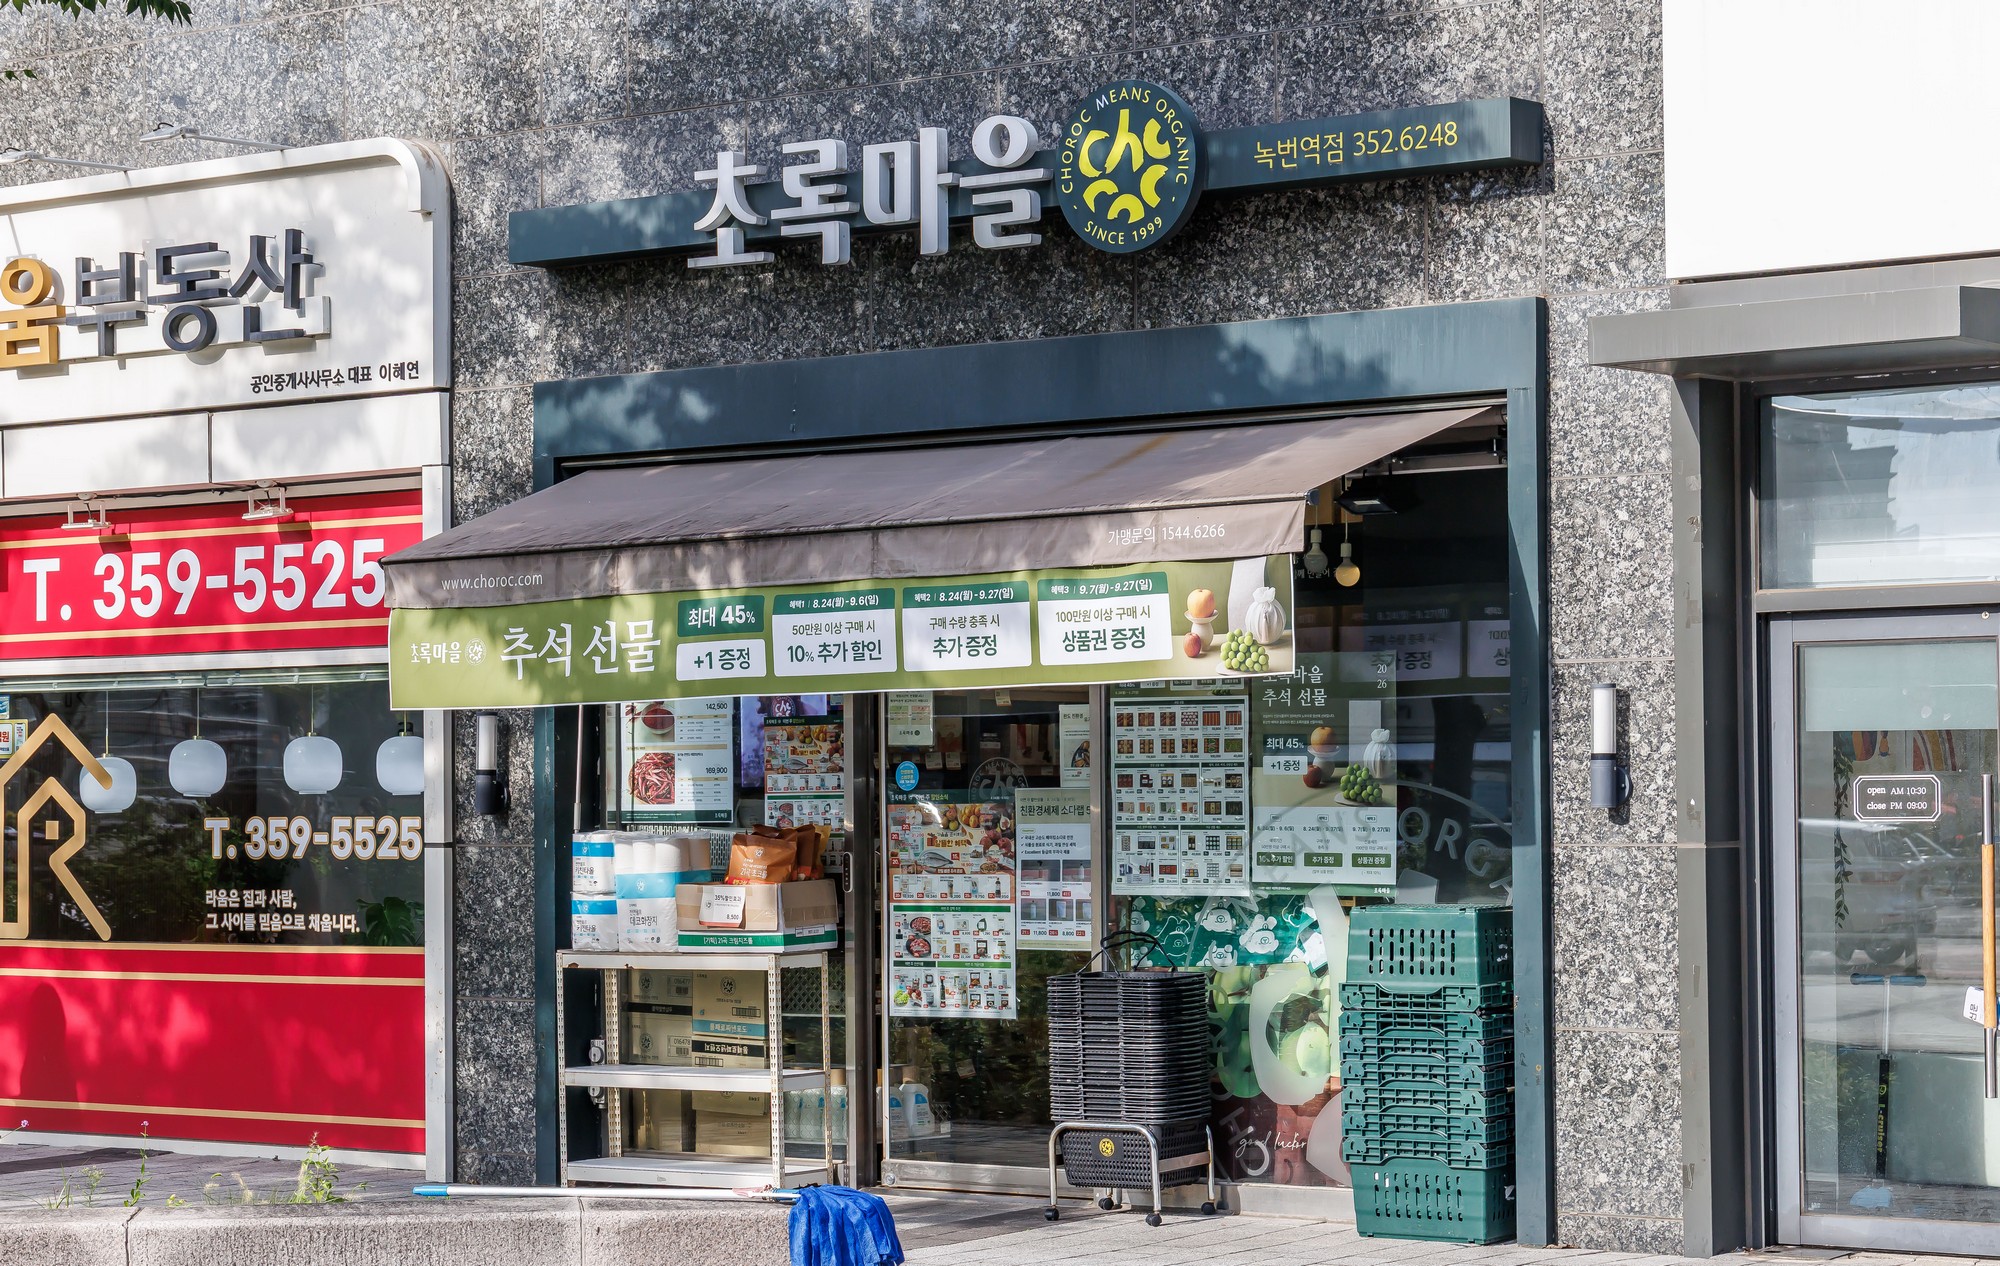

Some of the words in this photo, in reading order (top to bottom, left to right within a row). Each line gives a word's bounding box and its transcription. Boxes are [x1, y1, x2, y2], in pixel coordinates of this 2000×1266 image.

[1061, 109, 1092, 194] CHOROC
[1096, 87, 1151, 112] MEANS
[1155, 98, 1190, 186] ORGANIC
[1254, 132, 1344, 169] 녹번역점
[1353, 121, 1458, 157] 352.6248
[687, 115, 1053, 269] 초록마을
[1084, 220, 1125, 245] SINCE
[1132, 216, 1162, 242] 1999
[250, 371, 345, 394] 공인중개사사무소
[347, 366, 373, 383] 대표
[379, 360, 420, 383] 이혜연
[1108, 527, 1155, 546] 가맹문의
[1162, 524, 1225, 541] 1544.6266
[23, 557, 73, 622] T.
[93, 538, 385, 620] 359-5525
[441, 572, 543, 591] www.choroc.com
[914, 592, 931, 602] 혜택2
[1050, 585, 1069, 595] 혜택3
[789, 600, 805, 609] 혜택1
[688, 607, 716, 628] 최대
[721, 605, 755, 625] 45%
[929, 616, 947, 629] 구매
[949, 615, 967, 629] 수량
[969, 614, 988, 628] 충족
[990, 613, 1000, 627] 시
[1055, 608, 1091, 624] 100만원
[1094, 607, 1113, 622] 이상
[1115, 606, 1138, 621] 구매
[1140, 605, 1151, 619] 시
[792, 622, 822, 636] 50만원
[824, 621, 842, 635] 이상
[844, 620, 864, 634] 구매
[866, 619, 876, 633] 시
[932, 636, 962, 659] 추가
[965, 634, 998, 657] 증정
[1062, 630, 1107, 652] 상품권
[1110, 626, 1146, 649] 증정
[410, 640, 462, 664] 초록마을
[500, 622, 572, 680] 추석
[583, 618, 661, 675] 선물
[787, 645, 814, 663] 10%
[817, 641, 848, 664] 추가
[851, 639, 882, 662] 할인
[694, 651, 713, 670] +1
[718, 647, 750, 671] 증정
[1377, 664, 1387, 674] 20
[1377, 679, 1387, 689] 26
[706, 703, 728, 711] 142,500
[1262, 688, 1291, 708] 추석
[1298, 688, 1327, 707] 선물
[1266, 738, 1284, 750] 최대
[1286, 738, 1304, 749] 45%
[706, 767, 728, 775] 169,900
[1271, 761, 1281, 770] +1
[1283, 760, 1300, 772] 증정
[1867, 786, 1886, 795] open
[1891, 787, 1904, 795] AM
[1906, 786, 1927, 795] 10:30
[1020, 805, 1059, 816] 친환경세제
[1061, 805, 1084, 816] 소다랩
[1867, 801, 1886, 810] close
[1890, 801, 1903, 810] PM
[1906, 801, 1928, 810] 09:00
[204, 817, 237, 860] T.
[245, 816, 422, 861] 359-5525
[1312, 856, 1323, 864] 추가
[1324, 856, 1334, 864] 증정
[1357, 857, 1373, 865] 상품권
[1374, 857, 1386, 865] 증정
[205, 889, 241, 909] 라움은
[243, 889, 267, 909] 집과
[269, 888, 297, 911] 사람,
[206, 916, 219, 931] 그
[221, 914, 256, 933] 사이를
[259, 913, 306, 932] 믿음으로
[308, 913, 360, 933] 채웁니다.
